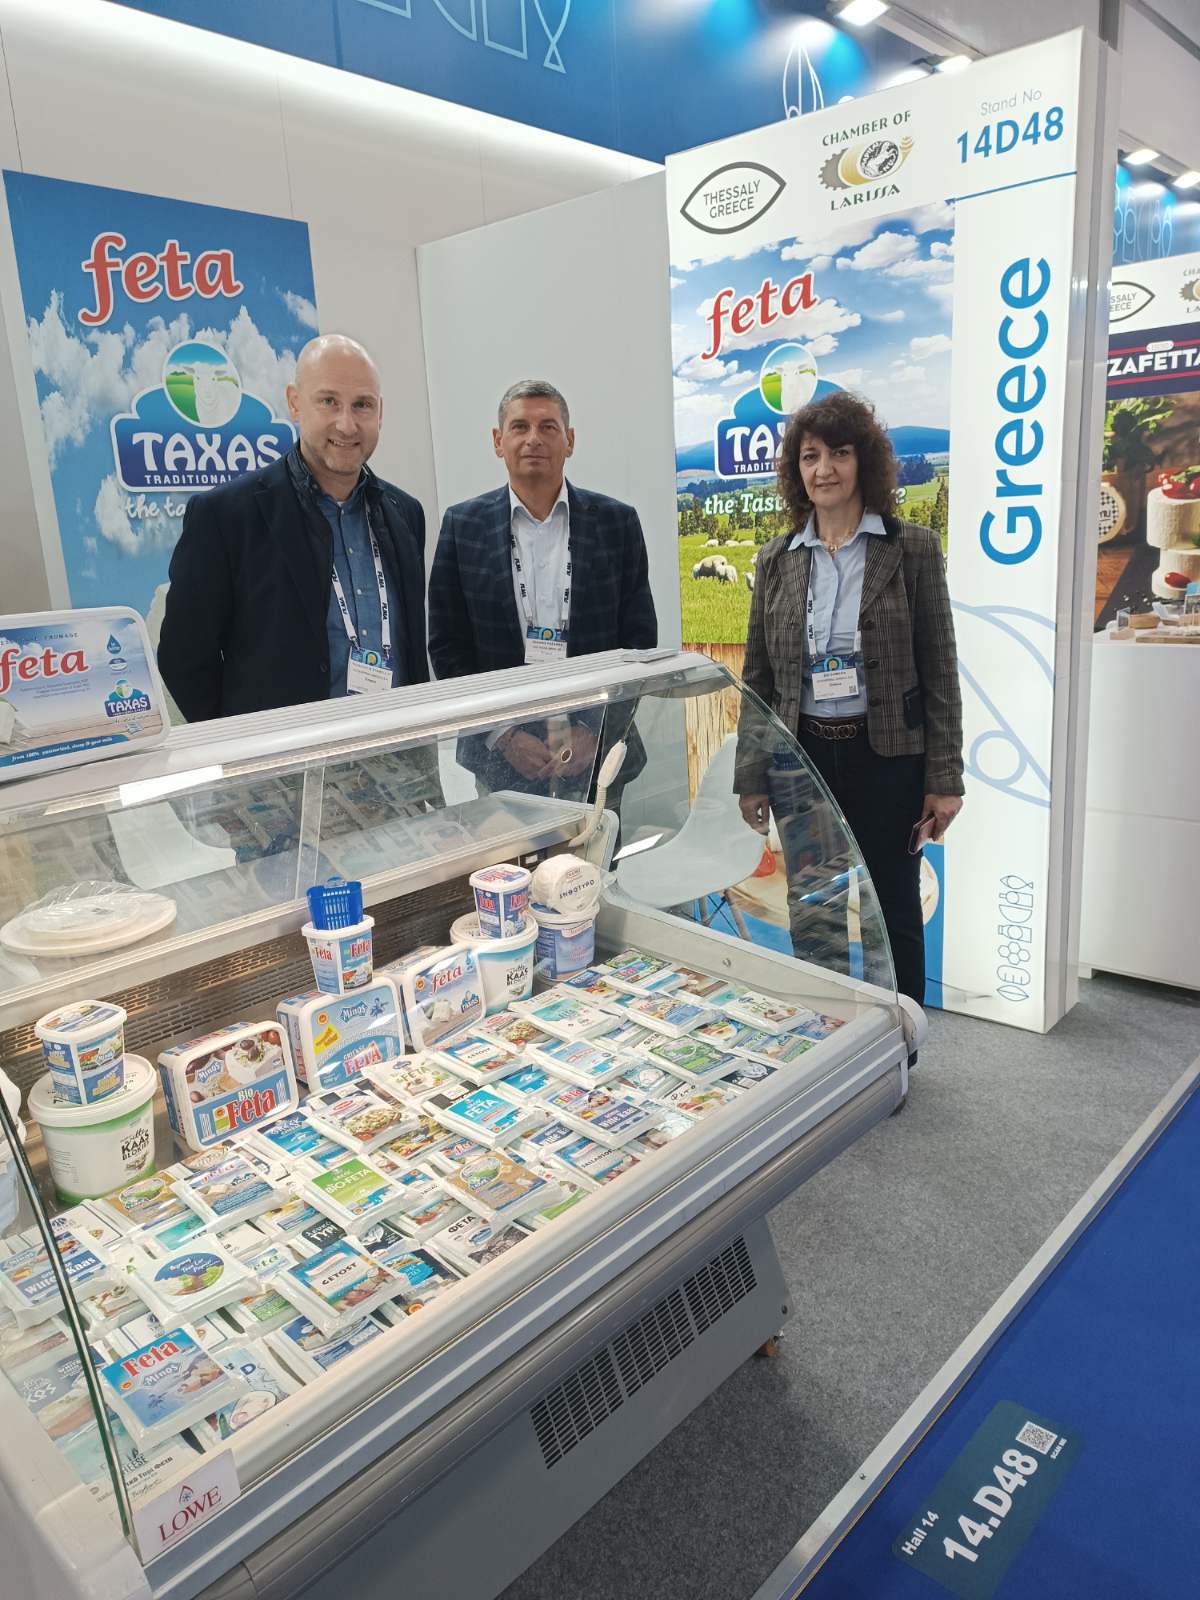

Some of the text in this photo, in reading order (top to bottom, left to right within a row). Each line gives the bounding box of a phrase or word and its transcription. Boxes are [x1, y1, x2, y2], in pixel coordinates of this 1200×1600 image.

[980, 88, 1043, 118] Stand No
[822, 110, 913, 147] CHAMBER OF
[956, 106, 1064, 164] 14D48
[703, 179, 761, 207] THESSALY
[709, 196, 755, 220] GREECE
[830, 184, 901, 212] LARISSA
[80, 233, 242, 325] feta
[701, 271, 817, 360] feta
[979, 257, 1051, 566] Greece
[132, 432, 282, 471] TAXAS
[126, 494, 160, 519] the
[704, 493, 786, 515] the Tast
[0, 647, 90, 694] feta
[108, 696, 148, 713] TAXAS
[430, 965, 462, 993] feta
[506, 966, 529, 983] KAAS
[198, 1061, 220, 1080] Minos
[343, 1042, 382, 1076] FETA
[225, 1088, 276, 1130] Feta
[464, 1099, 498, 1118] FETA
[120, 1131, 150, 1155] KAAS
[321, 1261, 358, 1286] GETOST
[121, 1340, 180, 1378] Feta
[144, 1362, 180, 1387] Minos
[158, 1485, 222, 1541] LOWE
[941, 1448, 1039, 1562] 14.D48
[901, 1510, 940, 1556] Hall 14
